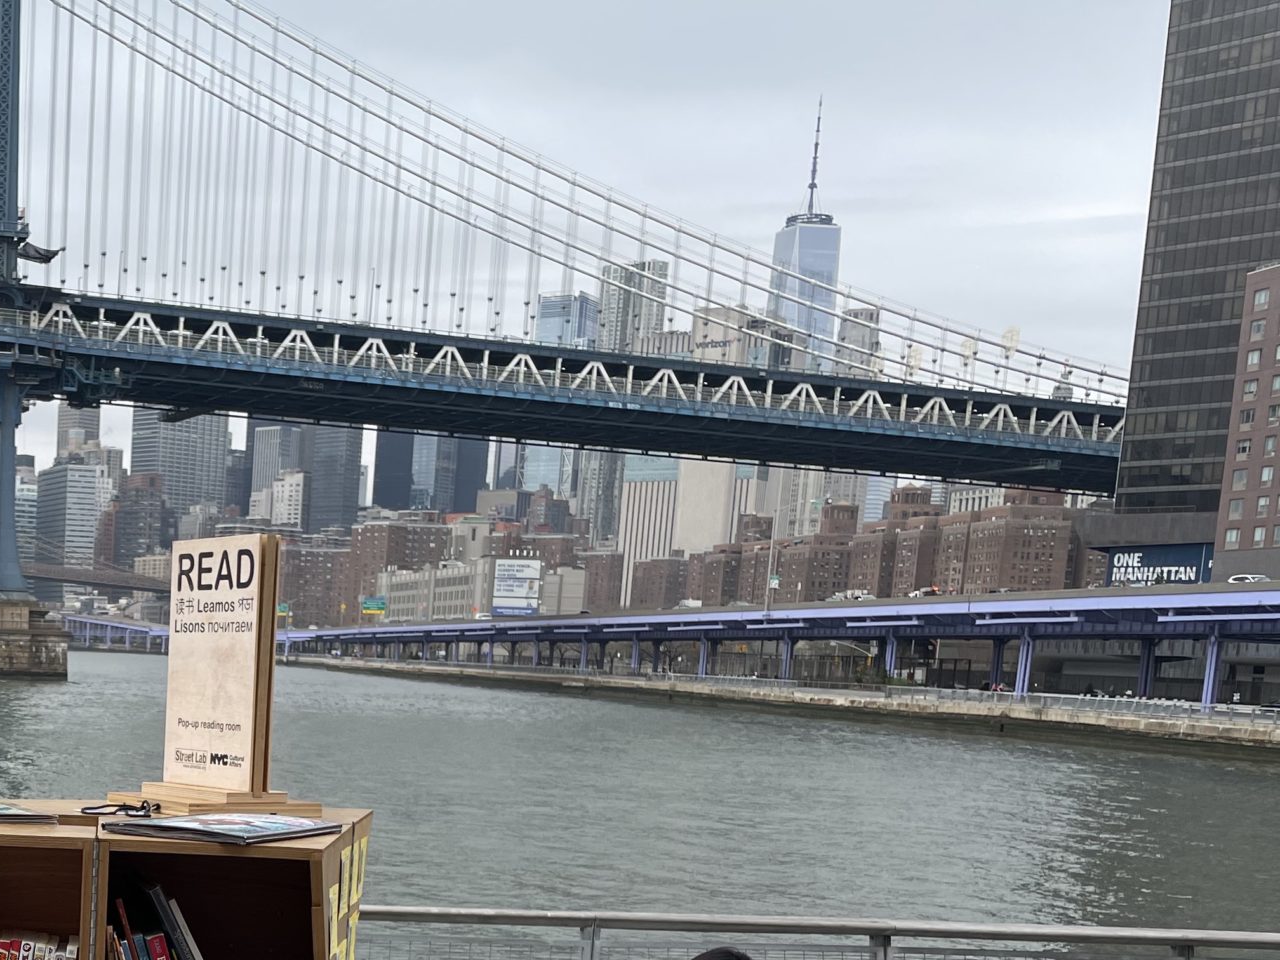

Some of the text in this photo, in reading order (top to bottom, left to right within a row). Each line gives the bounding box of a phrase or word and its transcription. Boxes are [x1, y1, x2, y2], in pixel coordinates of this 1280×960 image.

[695, 339, 730, 349] verizon
[1114, 553, 1143, 567] ONE
[178, 549, 254, 592] READ
[1112, 567, 1196, 581] MANHATTAN
[176, 598, 194, 615] 读书
[198, 599, 235, 613] Leamos
[175, 619, 205, 633] Lisons
[208, 621, 253, 633] почитаем
[178, 718, 241, 732] Pop-up reading room
[176, 750, 206, 763] Street Lab
[210, 753, 228, 766] NYC
